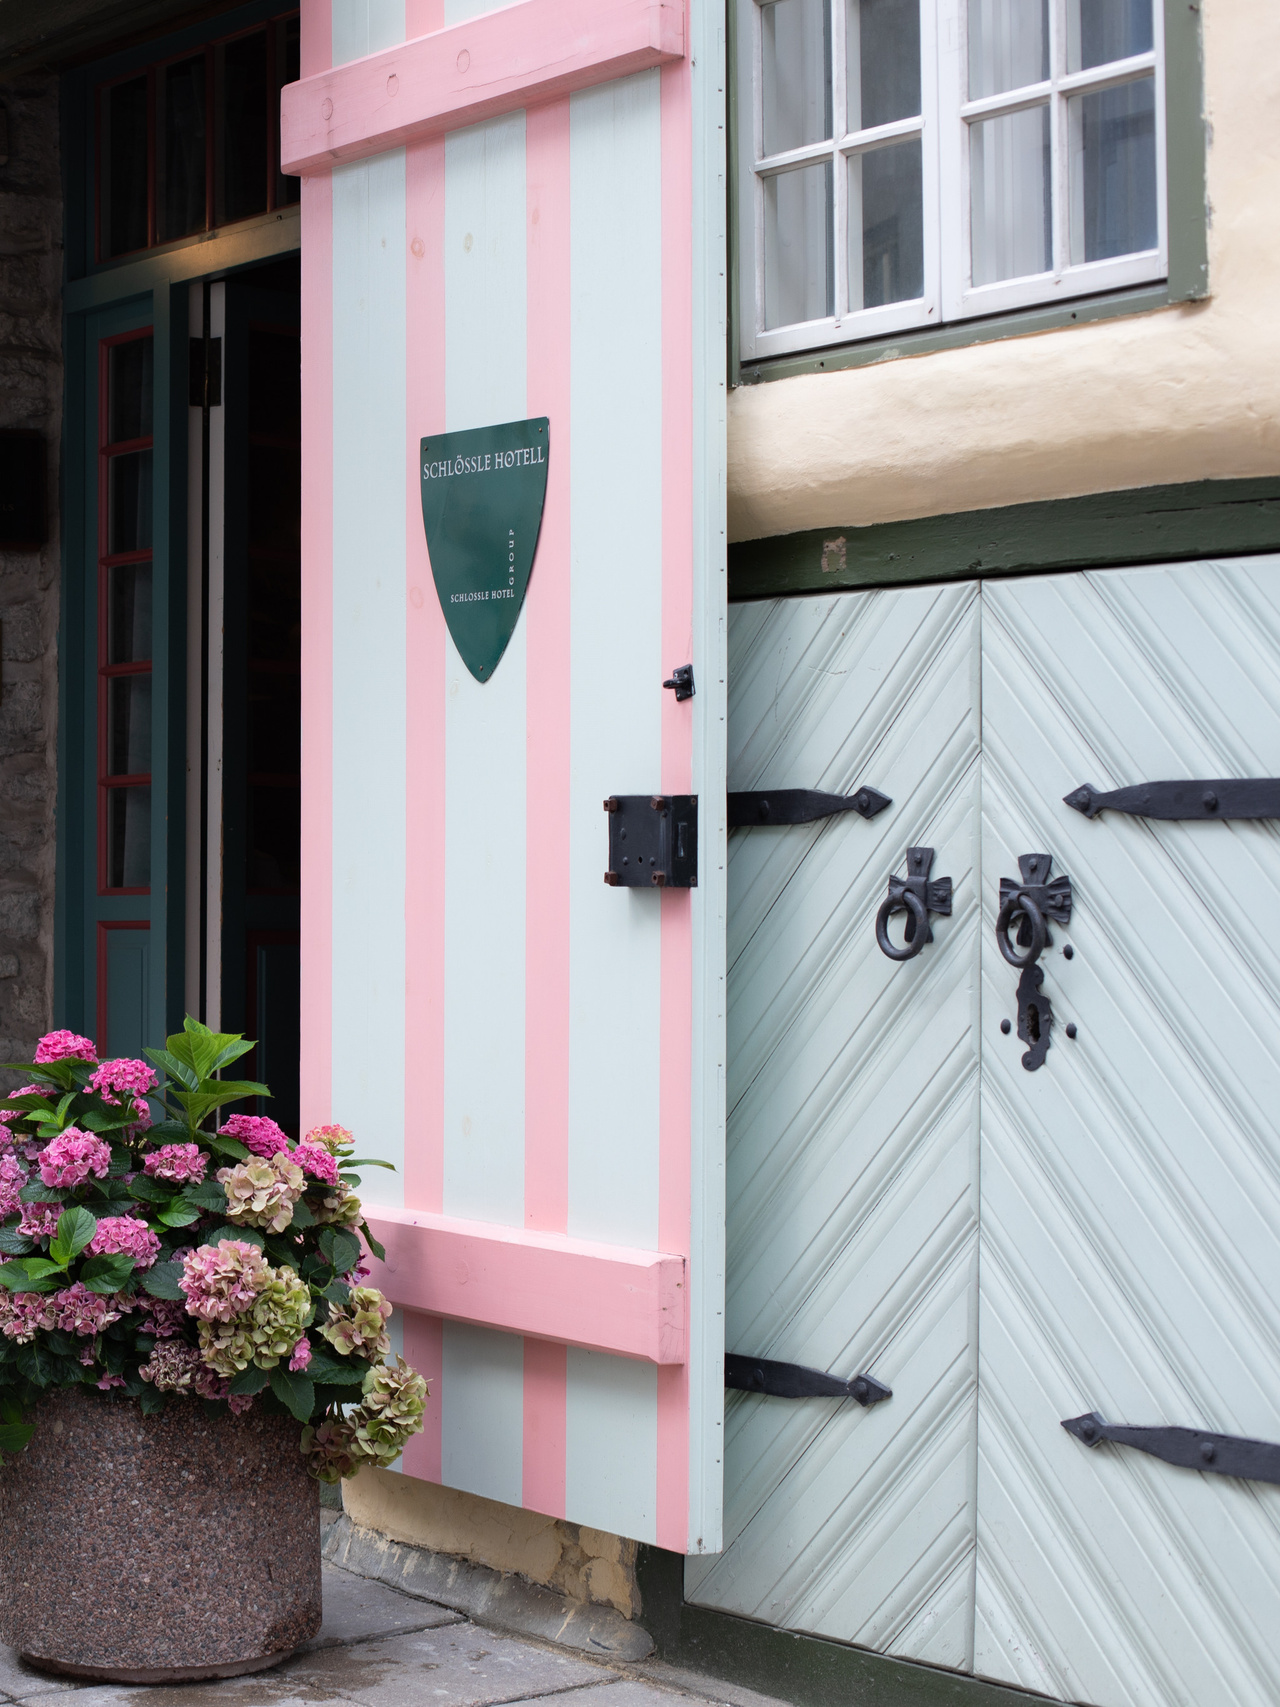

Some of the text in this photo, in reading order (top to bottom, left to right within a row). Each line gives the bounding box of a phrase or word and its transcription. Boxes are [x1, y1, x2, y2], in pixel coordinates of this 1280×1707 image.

[423, 446, 545, 480] SCHLÖSSLE HOTELL
[508, 528, 516, 586] GROUP
[491, 589, 515, 601] HOTEL
